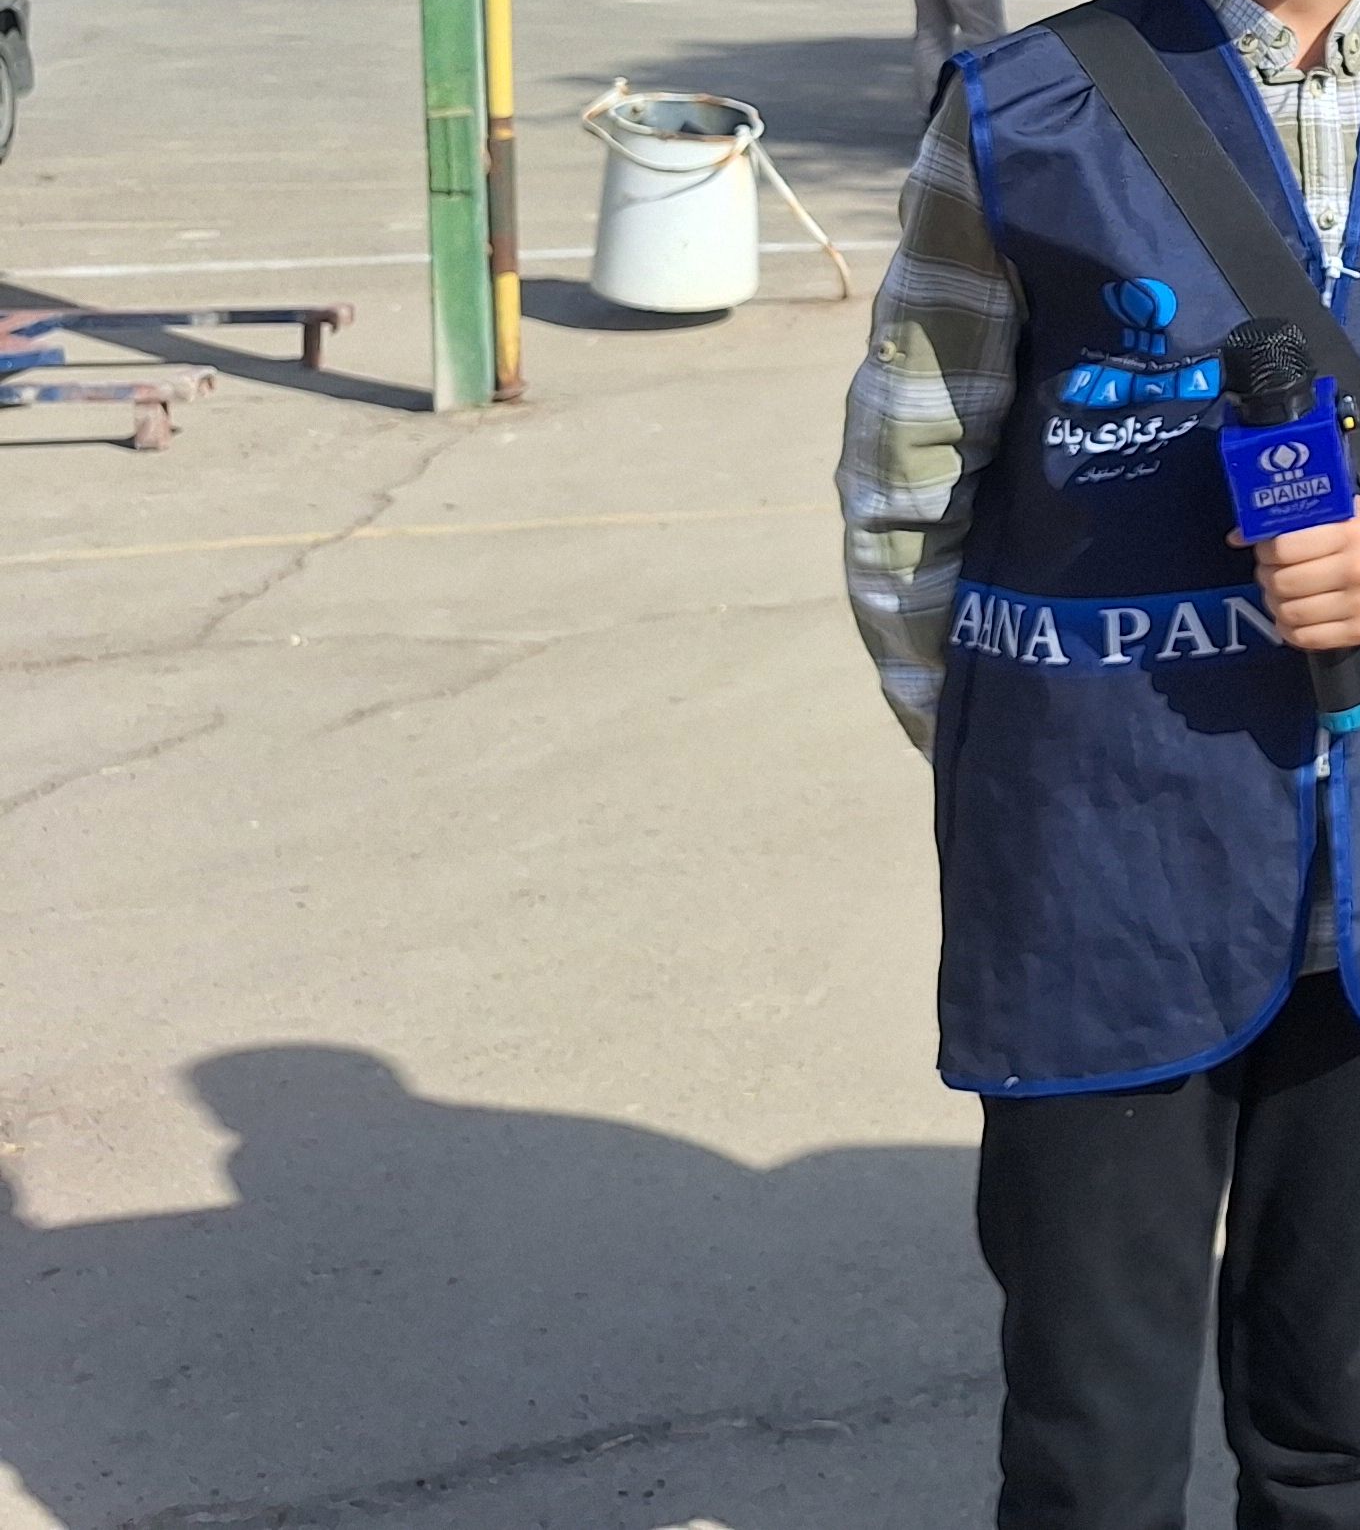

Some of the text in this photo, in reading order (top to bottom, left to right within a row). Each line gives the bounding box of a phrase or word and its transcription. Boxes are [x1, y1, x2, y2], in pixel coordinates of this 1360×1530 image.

[1066, 366, 1214, 406] PANA
[1045, 414, 1200, 456] خبرگزاری پانا
[1257, 478, 1330, 506] PANA
[1099, 596, 1284, 666] PAN
